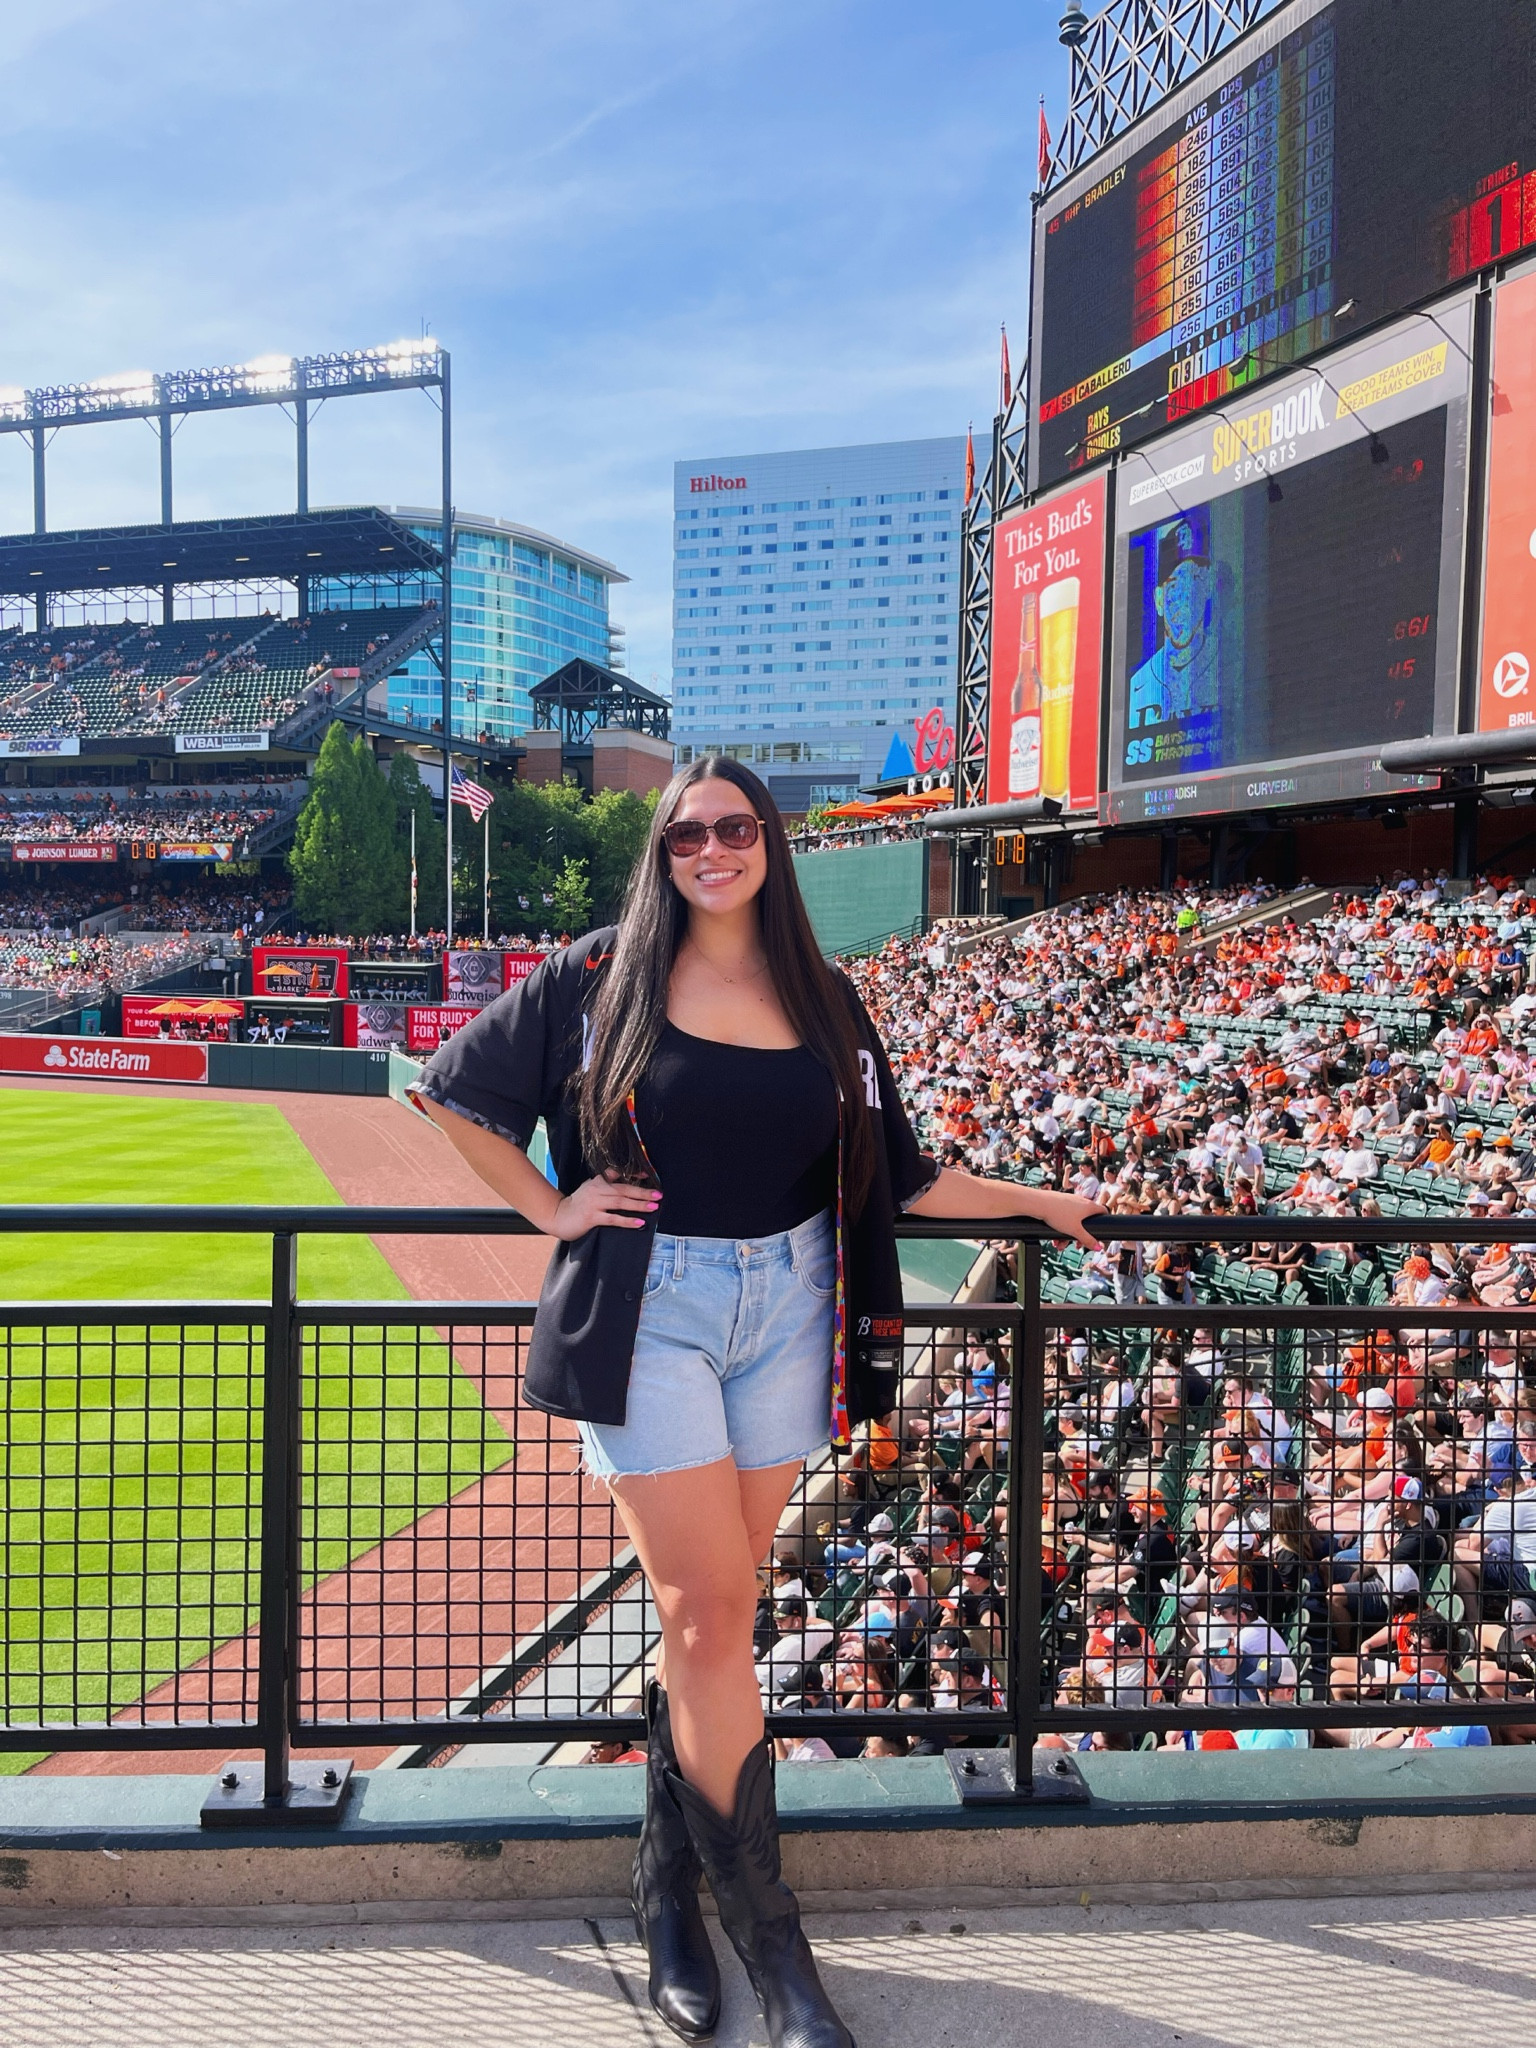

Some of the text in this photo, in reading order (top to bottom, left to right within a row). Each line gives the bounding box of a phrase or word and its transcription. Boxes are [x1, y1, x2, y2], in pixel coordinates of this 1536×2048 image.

[1185, 102, 1208, 131] AVG
[1220, 79, 1243, 105] OPS
[1184, 125, 1208, 154] .246
[1219, 99, 1243, 129] .673
[1184, 150, 1207, 177] .182
[1218, 123, 1243, 153] .653
[1064, 202, 1081, 223] RHP
[1085, 165, 1127, 209] BRADLEY
[1181, 197, 1206, 224] .205
[1216, 172, 1242, 201] .604
[1182, 173, 1207, 201] .296
[1476, 161, 1518, 196] STRIKES
[1181, 221, 1204, 248] .157
[1214, 197, 1241, 226] .563
[1488, 193, 1502, 257] 1
[1180, 244, 1204, 272] .267
[1214, 221, 1240, 250] .738
[1179, 269, 1202, 296] .190
[1214, 246, 1238, 274] .616
[1178, 293, 1202, 320] .255
[1213, 271, 1238, 299] .666
[1078, 359, 1132, 400] CABALLERO
[1177, 317, 1202, 343] .256
[1186, 342, 1191, 356] 2
[1087, 353, 1203, 434] RAYS 0 3 1
[1339, 362, 1442, 416] GREAT TEAMS COVER
[1345, 379, 1378, 400] GOOD
[1379, 364, 1410, 389] TEAMS
[1086, 425, 1121, 461] ORIOLES
[1213, 378, 1327, 475] SUPERBOOK
[1132, 460, 1203, 501] SUPERBOOK.COM
[1234, 441, 1297, 482] SPORTS
[690, 474, 747, 493] Hilton
[1005, 498, 1093, 558] This Bud's
[1014, 547, 1080, 589] For You.
[185, 737, 221, 749] WBAL
[1125, 737, 1154, 766] SS
[32, 848, 67, 859] JOHNSON
[68, 847, 98, 858] LUMBER
[135, 1019, 160, 1028] BEFOR
[413, 1010, 438, 1023] THIS
[413, 1025, 434, 1038] FOR
[369, 1053, 386, 1062] 410
[857, 1316, 871, 1335] B
